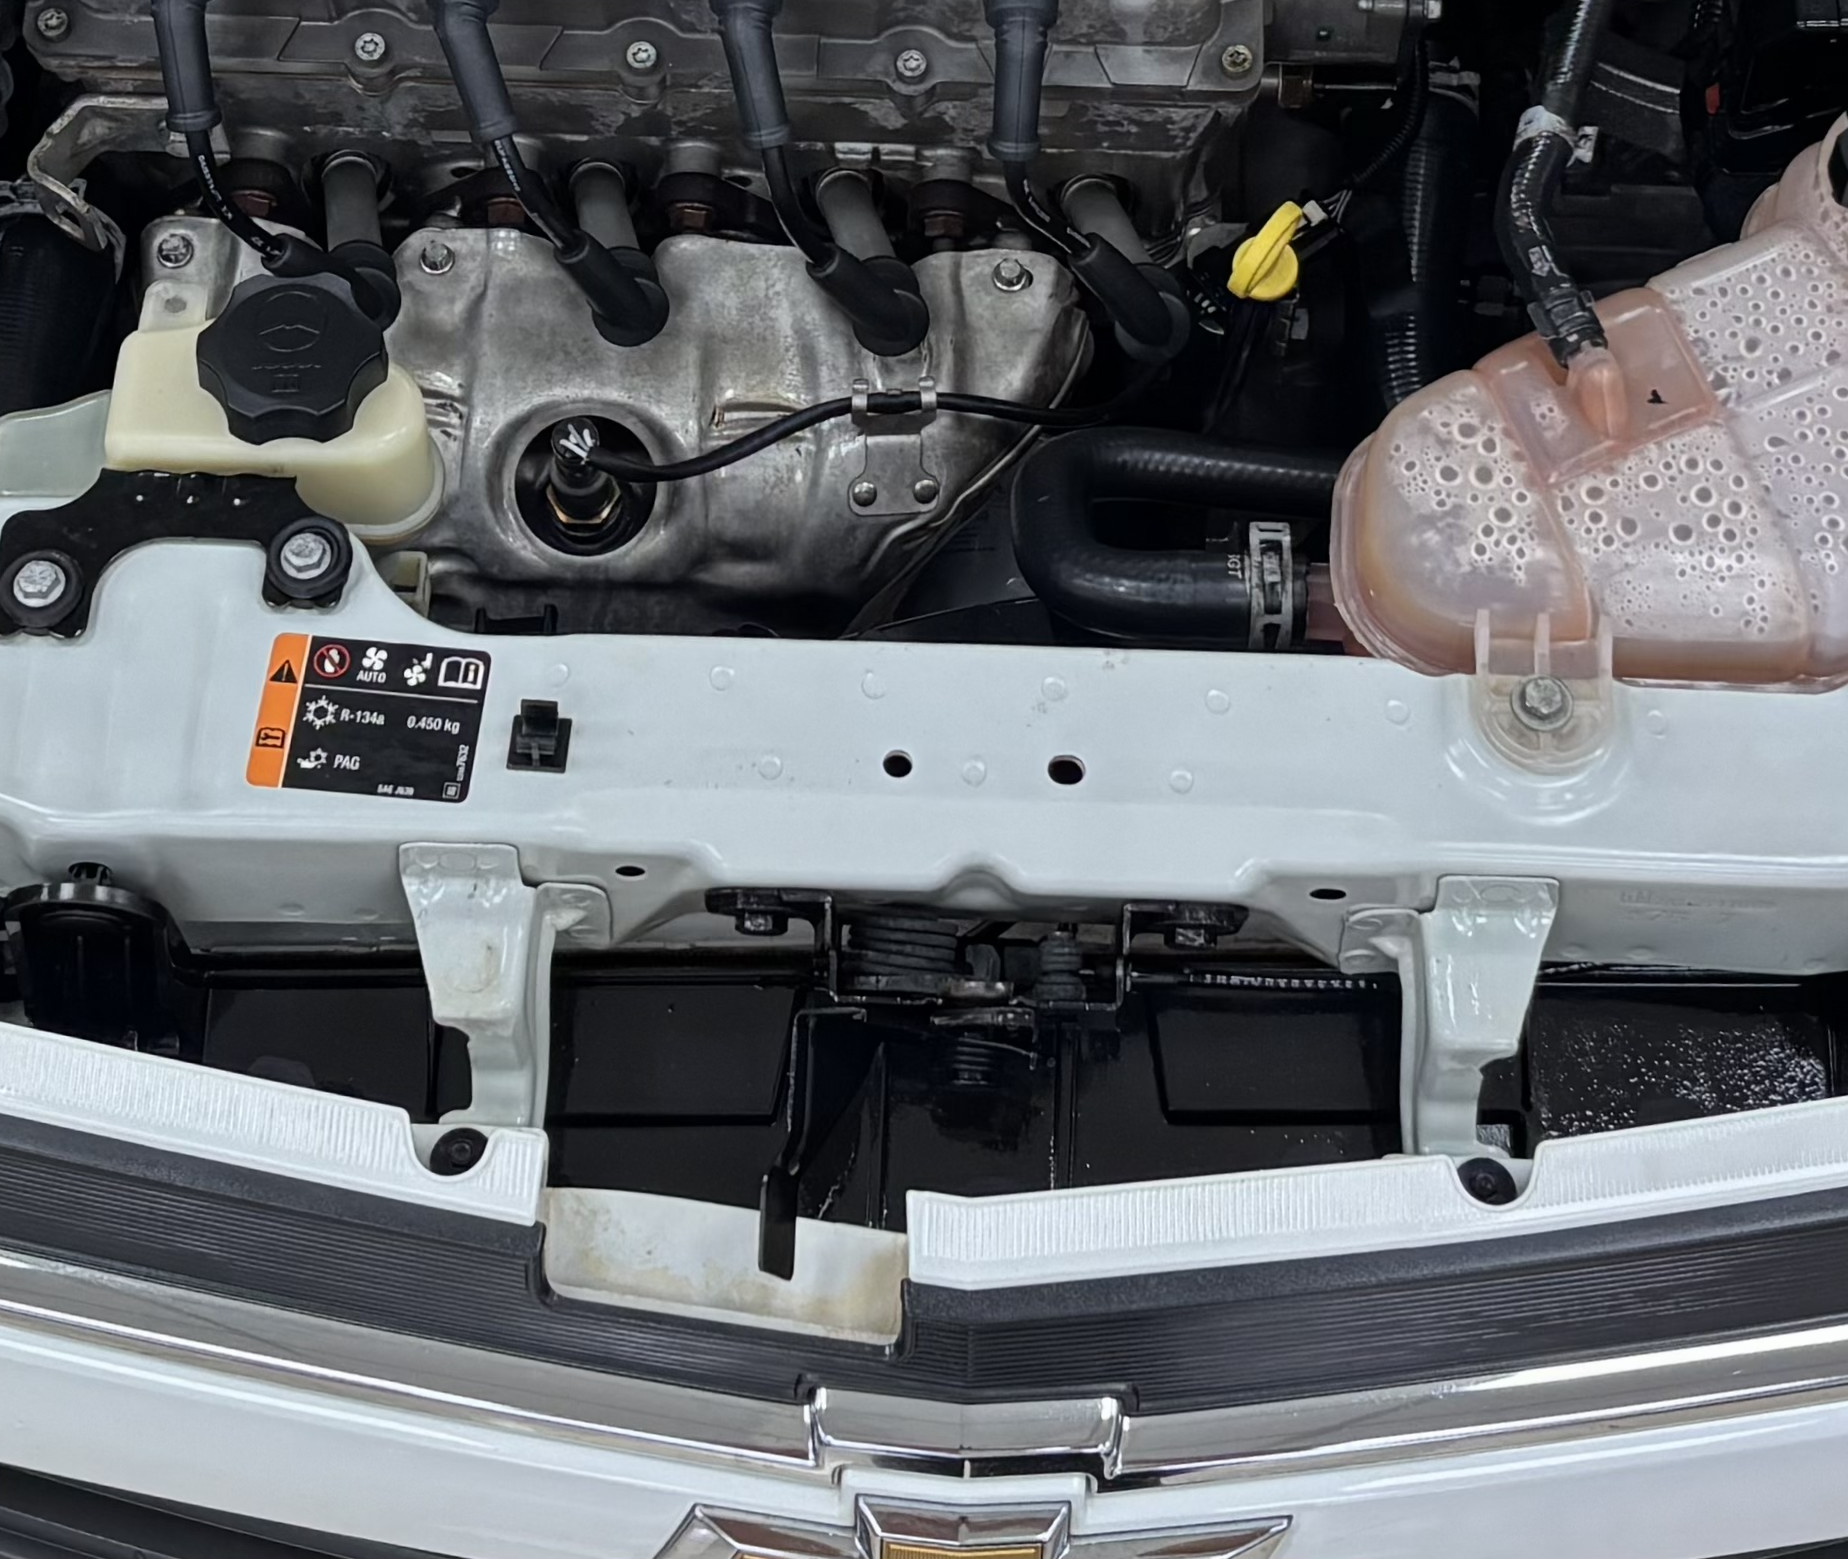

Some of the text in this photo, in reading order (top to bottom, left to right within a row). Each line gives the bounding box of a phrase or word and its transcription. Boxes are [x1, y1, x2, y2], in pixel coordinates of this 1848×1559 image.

[356, 670, 387, 683] AUTO
[340, 707, 461, 735] R-134a 0.450 kg
[333, 754, 360, 771] PAG
